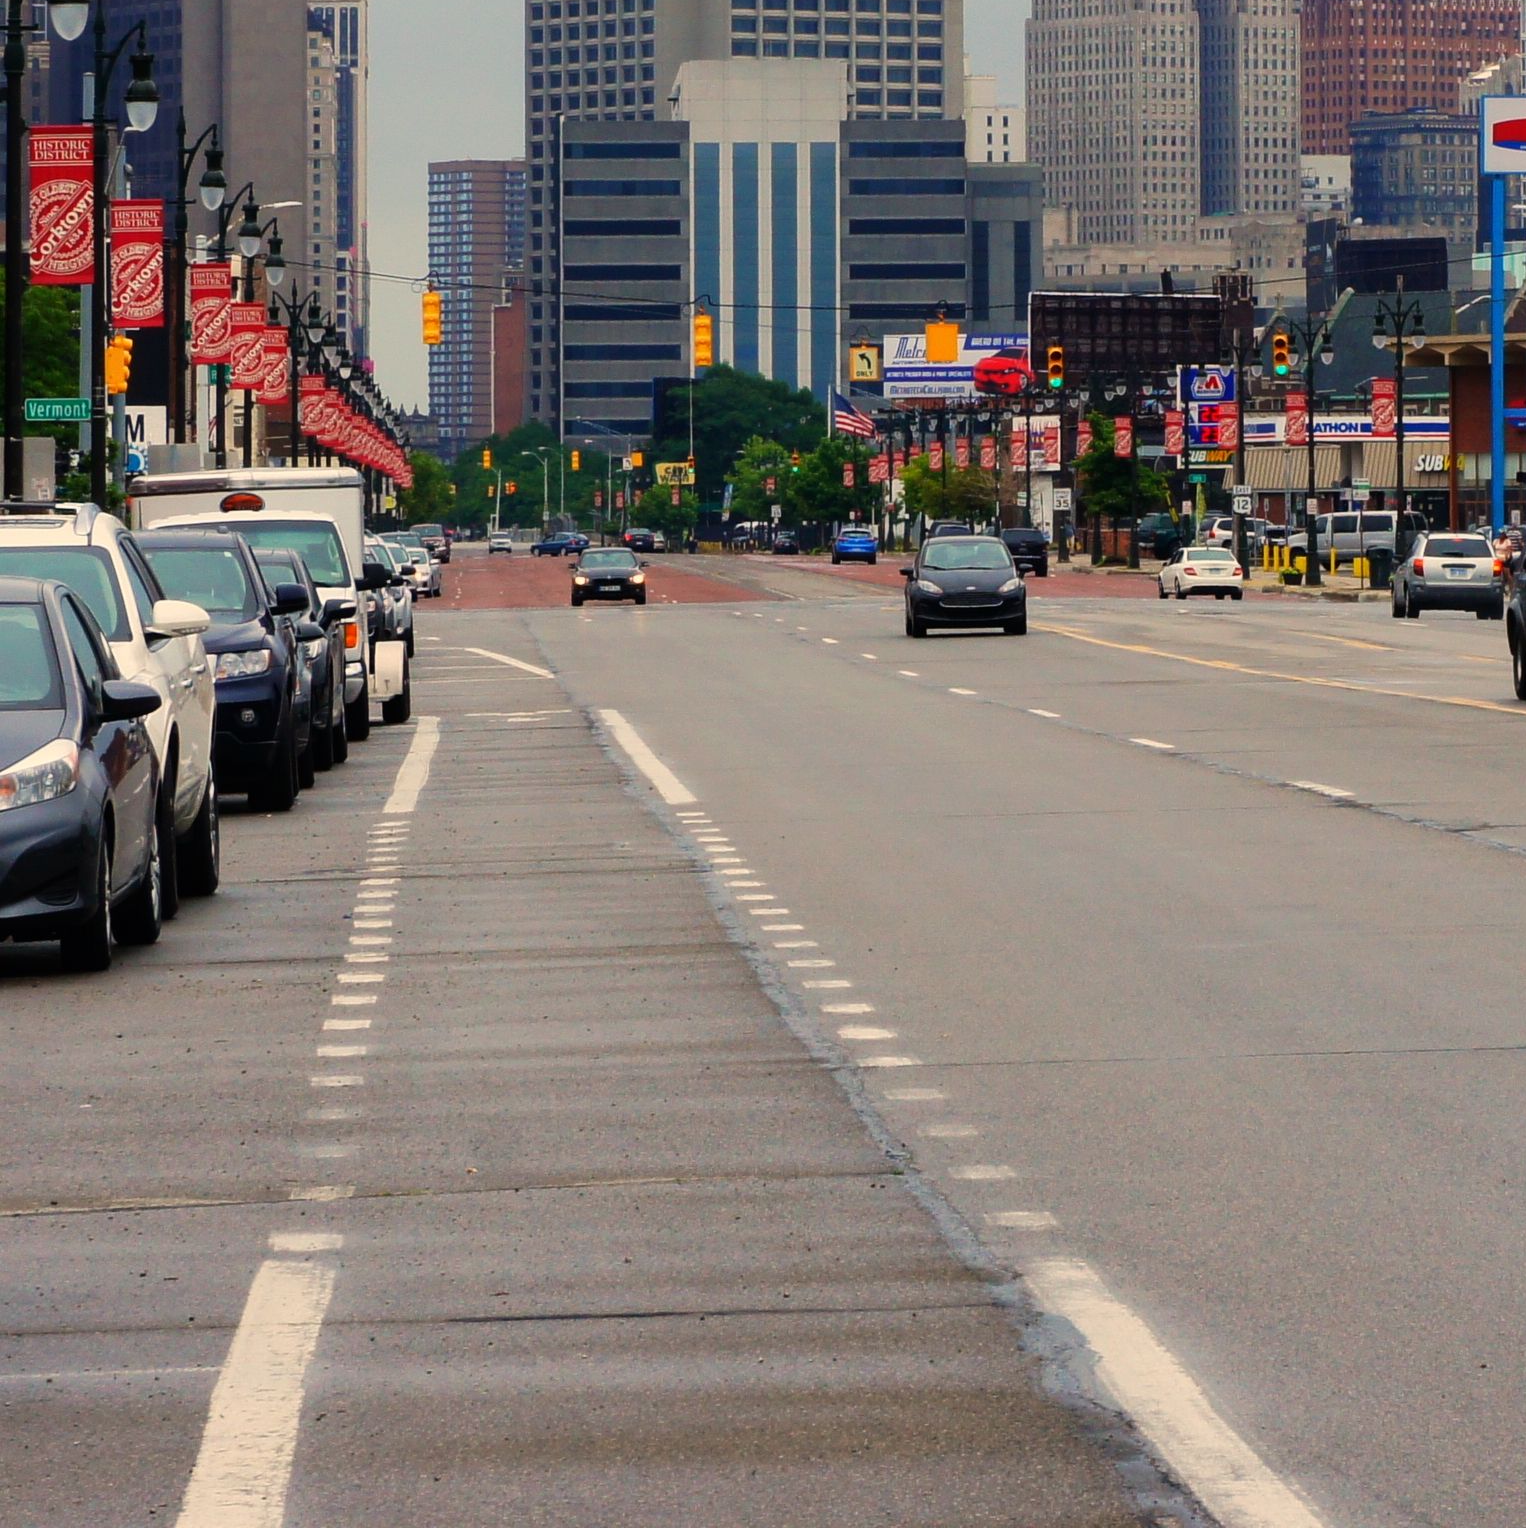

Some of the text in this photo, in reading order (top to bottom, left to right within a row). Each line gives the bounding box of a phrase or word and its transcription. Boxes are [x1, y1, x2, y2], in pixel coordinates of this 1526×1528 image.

[33, 139, 90, 150] HISTORIC
[35, 150, 88, 160] DISTRICT
[114, 211, 159, 219] HISTORIC
[30, 190, 94, 266] Corktown
[115, 219, 159, 227] DISTRICT
[112, 250, 163, 313] Corktown
[29, 402, 87, 417] Vermont
[1313, 423, 1358, 433] ATHON
[1055, 499, 1069, 508] 35
[1237, 499, 1249, 510] 12
